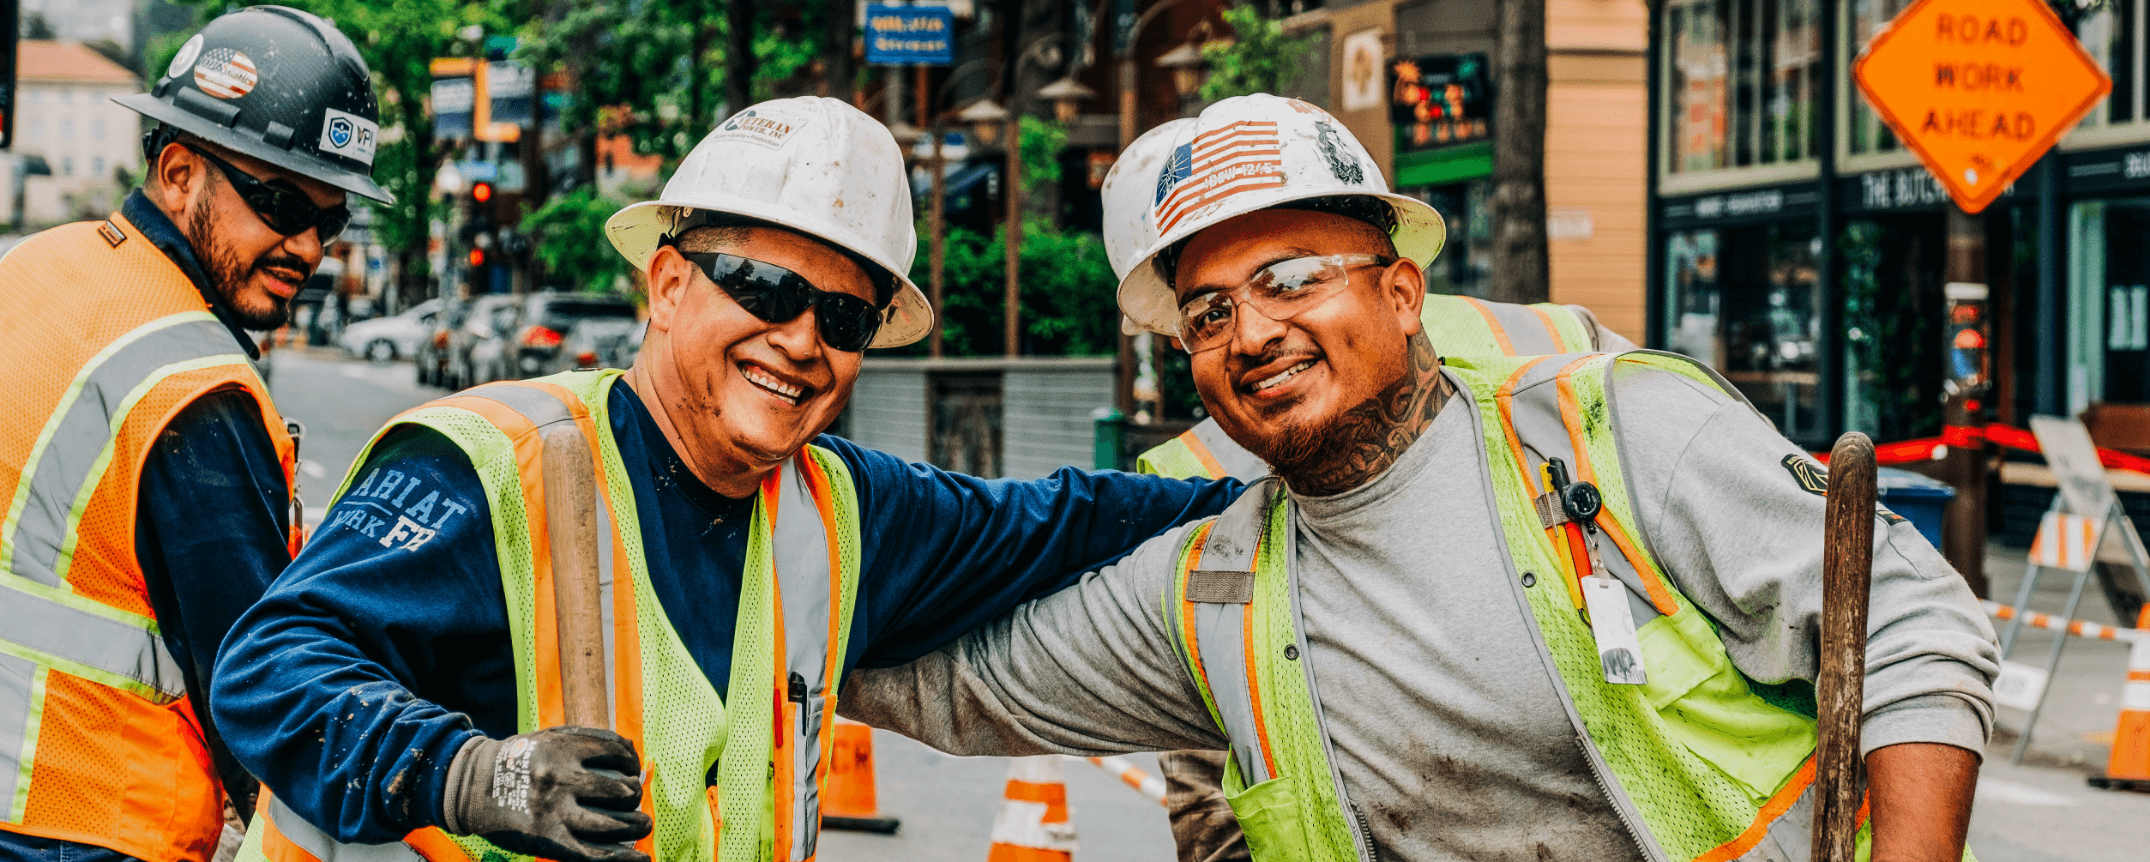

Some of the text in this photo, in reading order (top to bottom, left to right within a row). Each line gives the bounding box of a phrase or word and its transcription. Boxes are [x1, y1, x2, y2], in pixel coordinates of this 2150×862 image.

[1935, 13, 2028, 46] ROAD
[1933, 61, 2024, 93] WORK
[1919, 107, 2036, 141] AHEAD
[1204, 162, 1273, 189] IBEW 1245
[351, 467, 467, 530] ARIAT
[329, 509, 436, 553] WRK FR
